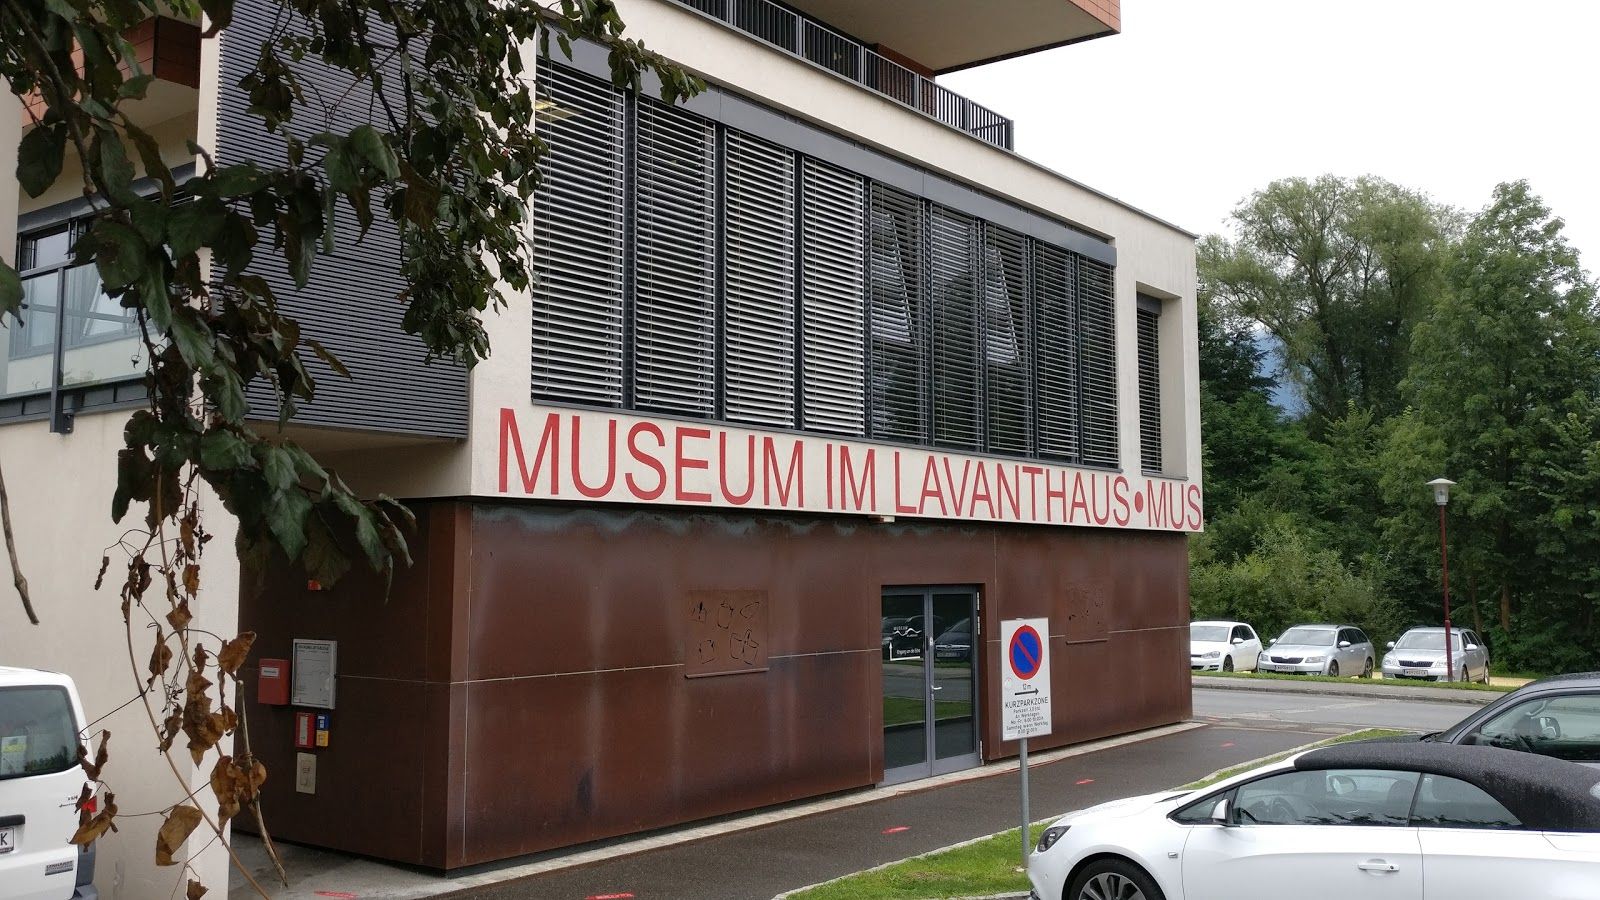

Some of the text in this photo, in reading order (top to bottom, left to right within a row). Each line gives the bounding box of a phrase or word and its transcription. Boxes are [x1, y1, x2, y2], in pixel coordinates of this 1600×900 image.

[498, 407, 804, 508] MUSEUM
[826, 442, 877, 512] IM
[1005, 696, 1048, 708] KURZPARKZONE
